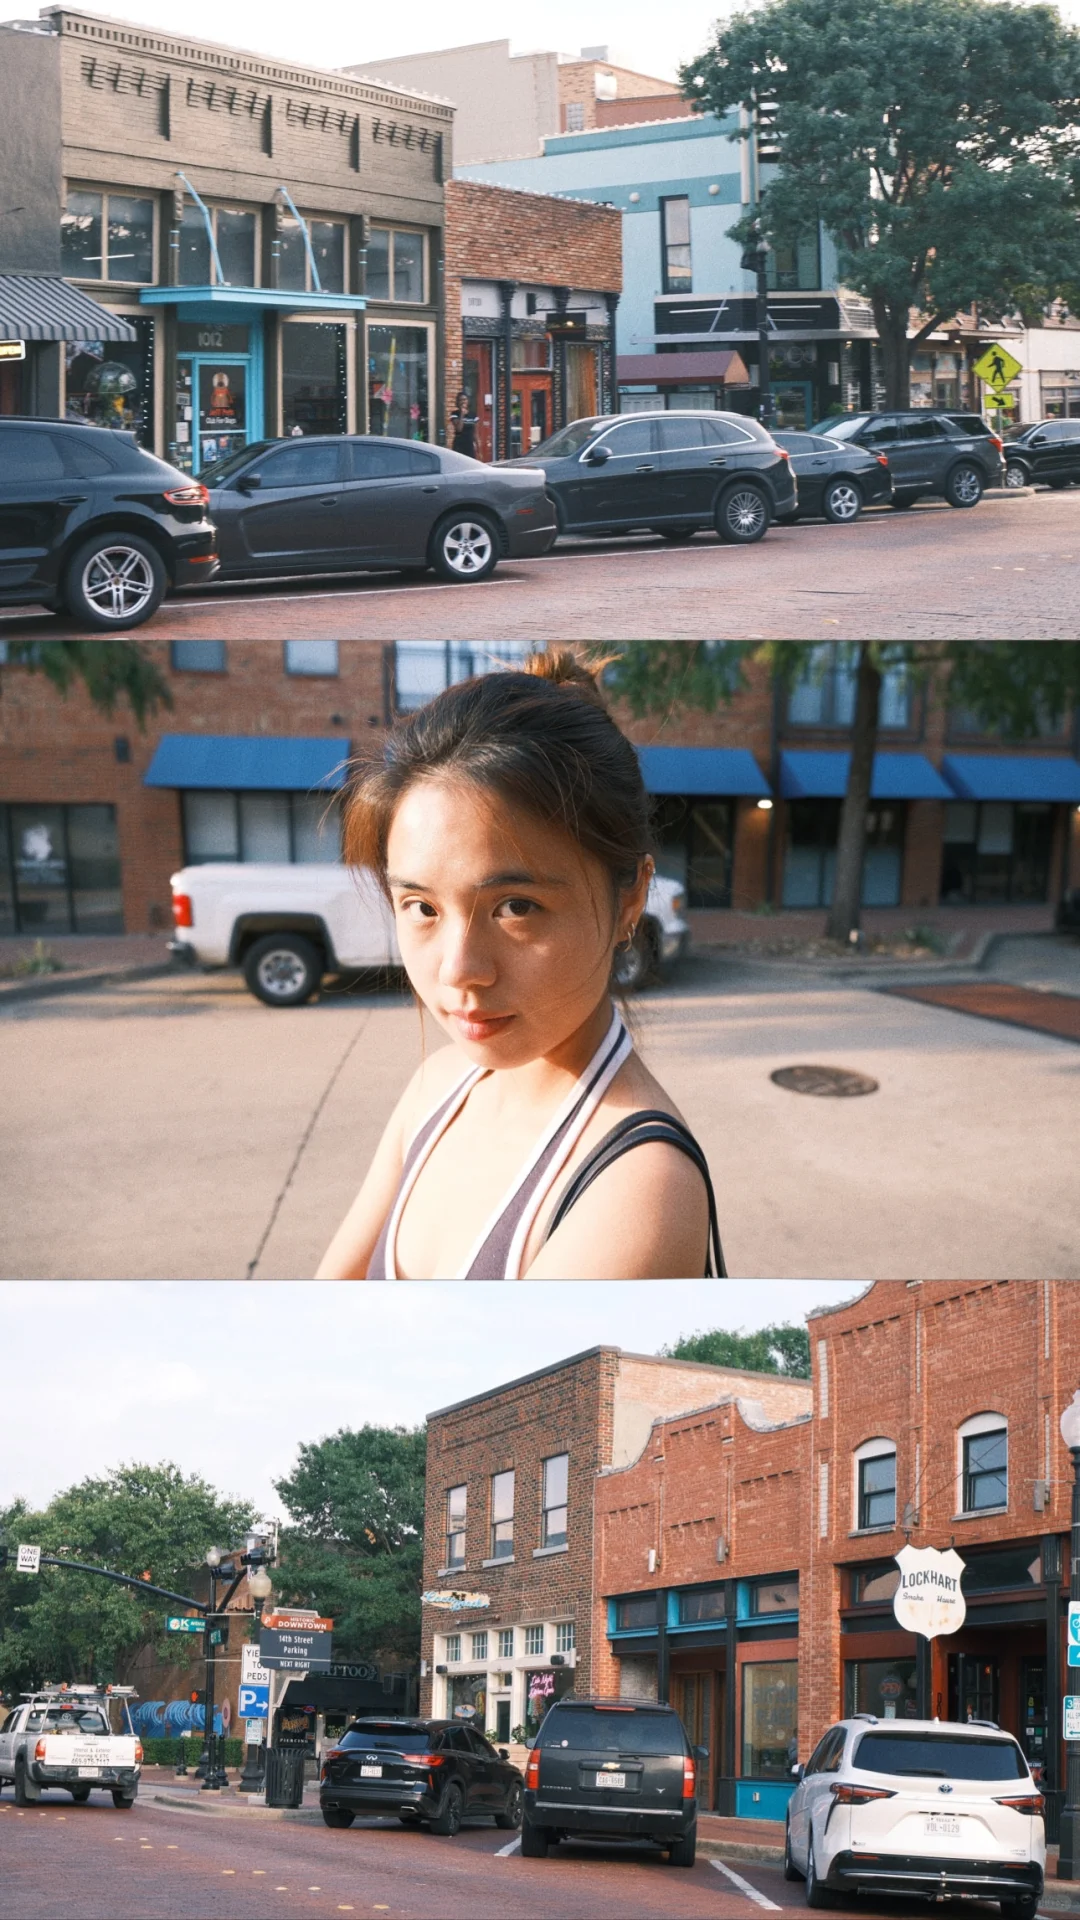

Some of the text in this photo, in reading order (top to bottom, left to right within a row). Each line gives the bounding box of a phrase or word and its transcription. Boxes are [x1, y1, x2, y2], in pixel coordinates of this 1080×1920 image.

[198, 332, 223, 347] 1012
[21, 1547, 38, 1555] ONE
[21, 1555, 37, 1563] WAY
[902, 1569, 957, 1592] LOCKHART
[180, 1618, 190, 1627] K
[278, 1621, 327, 1630] DOWNTOWN
[279, 1635, 314, 1644] 14th Street
[246, 1649, 260, 1657] YIE
[283, 1646, 308, 1656] Parking
[252, 1661, 262, 1669] TO
[294, 1661, 310, 1669] RIGHT
[322, 1665, 368, 1677] TTOO
[247, 1672, 268, 1681] PEDS
[240, 1690, 257, 1712] P
[1067, 1699, 1073, 1708] 3
